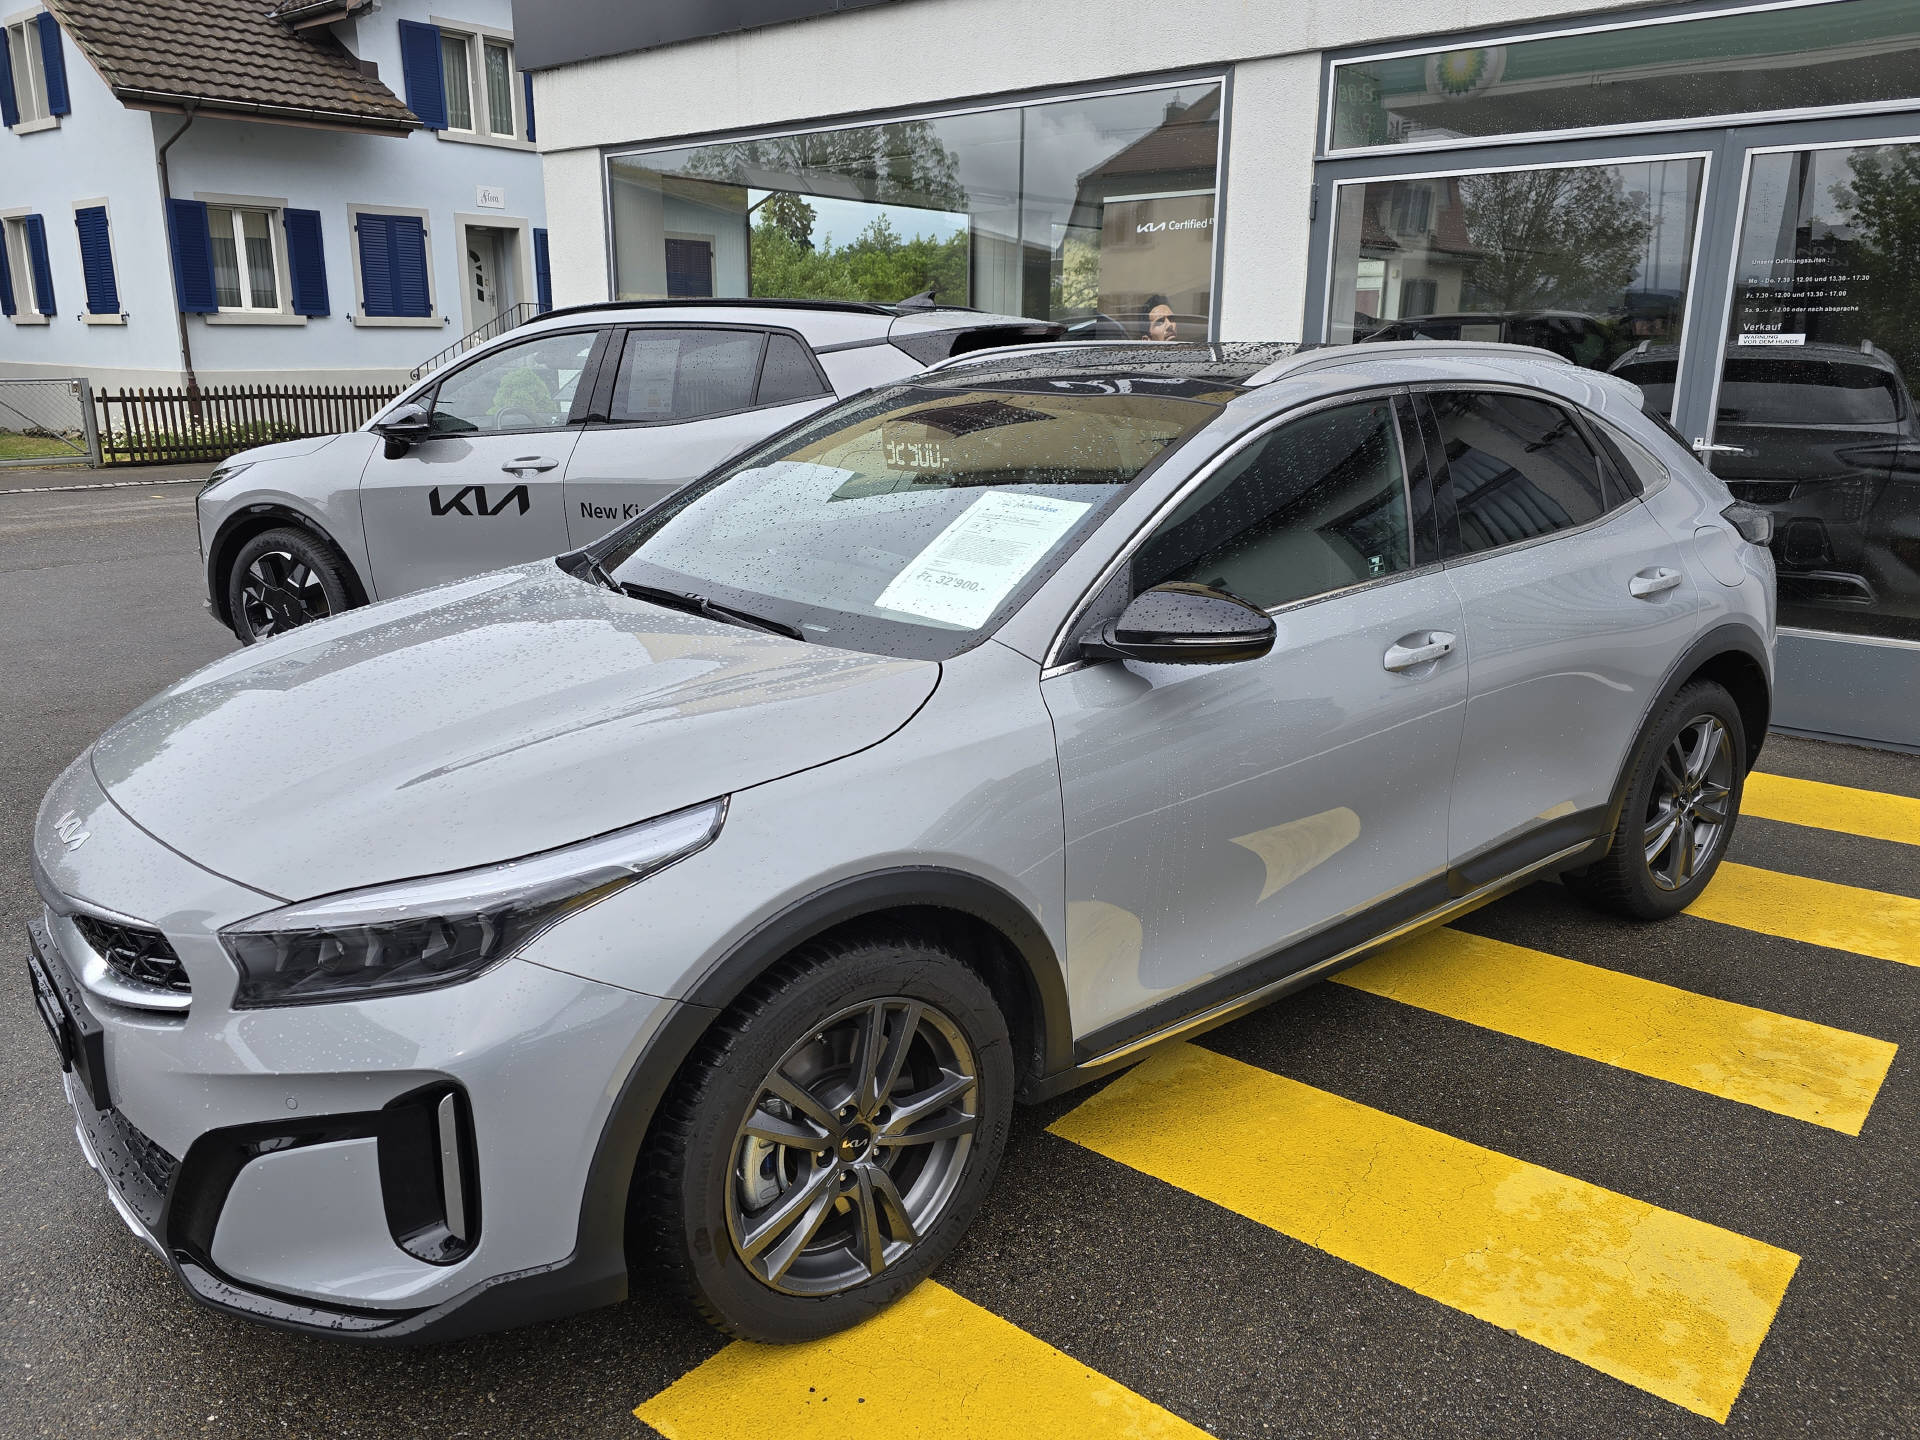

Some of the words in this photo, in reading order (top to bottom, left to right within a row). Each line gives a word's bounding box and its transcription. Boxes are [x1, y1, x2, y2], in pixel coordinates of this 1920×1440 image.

[1168, 218, 1208, 230] Certified
[1743, 322, 1782, 331] Verkauf
[428, 485, 530, 516] KIA
[580, 502, 618, 520] New
[622, 503, 646, 520] Ki
[917, 570, 932, 583] Fr.
